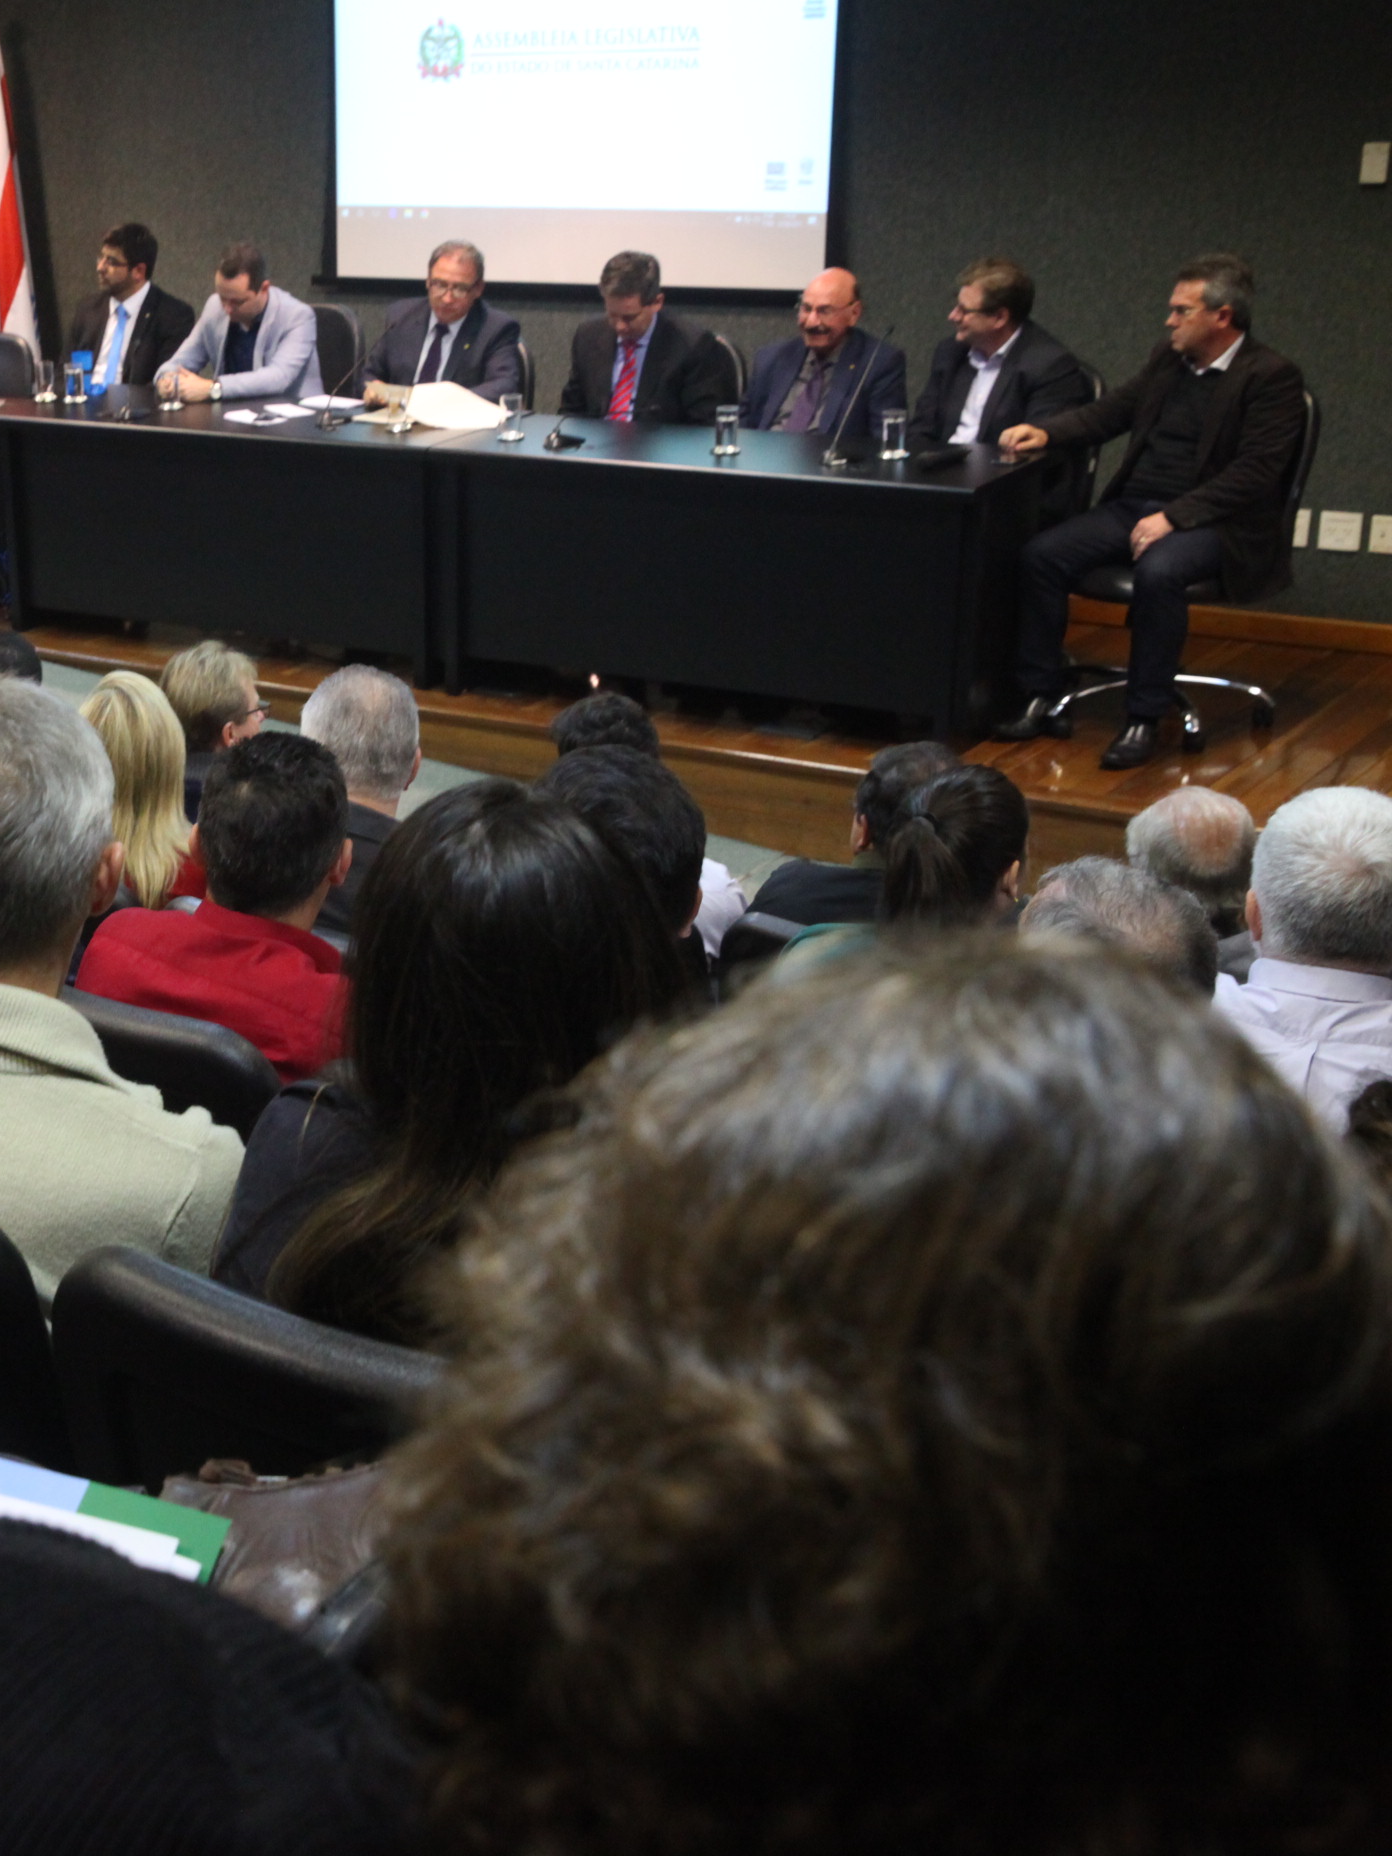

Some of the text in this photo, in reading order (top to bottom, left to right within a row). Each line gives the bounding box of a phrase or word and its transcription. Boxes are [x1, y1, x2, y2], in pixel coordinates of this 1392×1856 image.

[585, 26, 701, 46] LEGISLATIVA
[470, 57, 701, 74] DO ESTADO DE SANTA CATARINA
